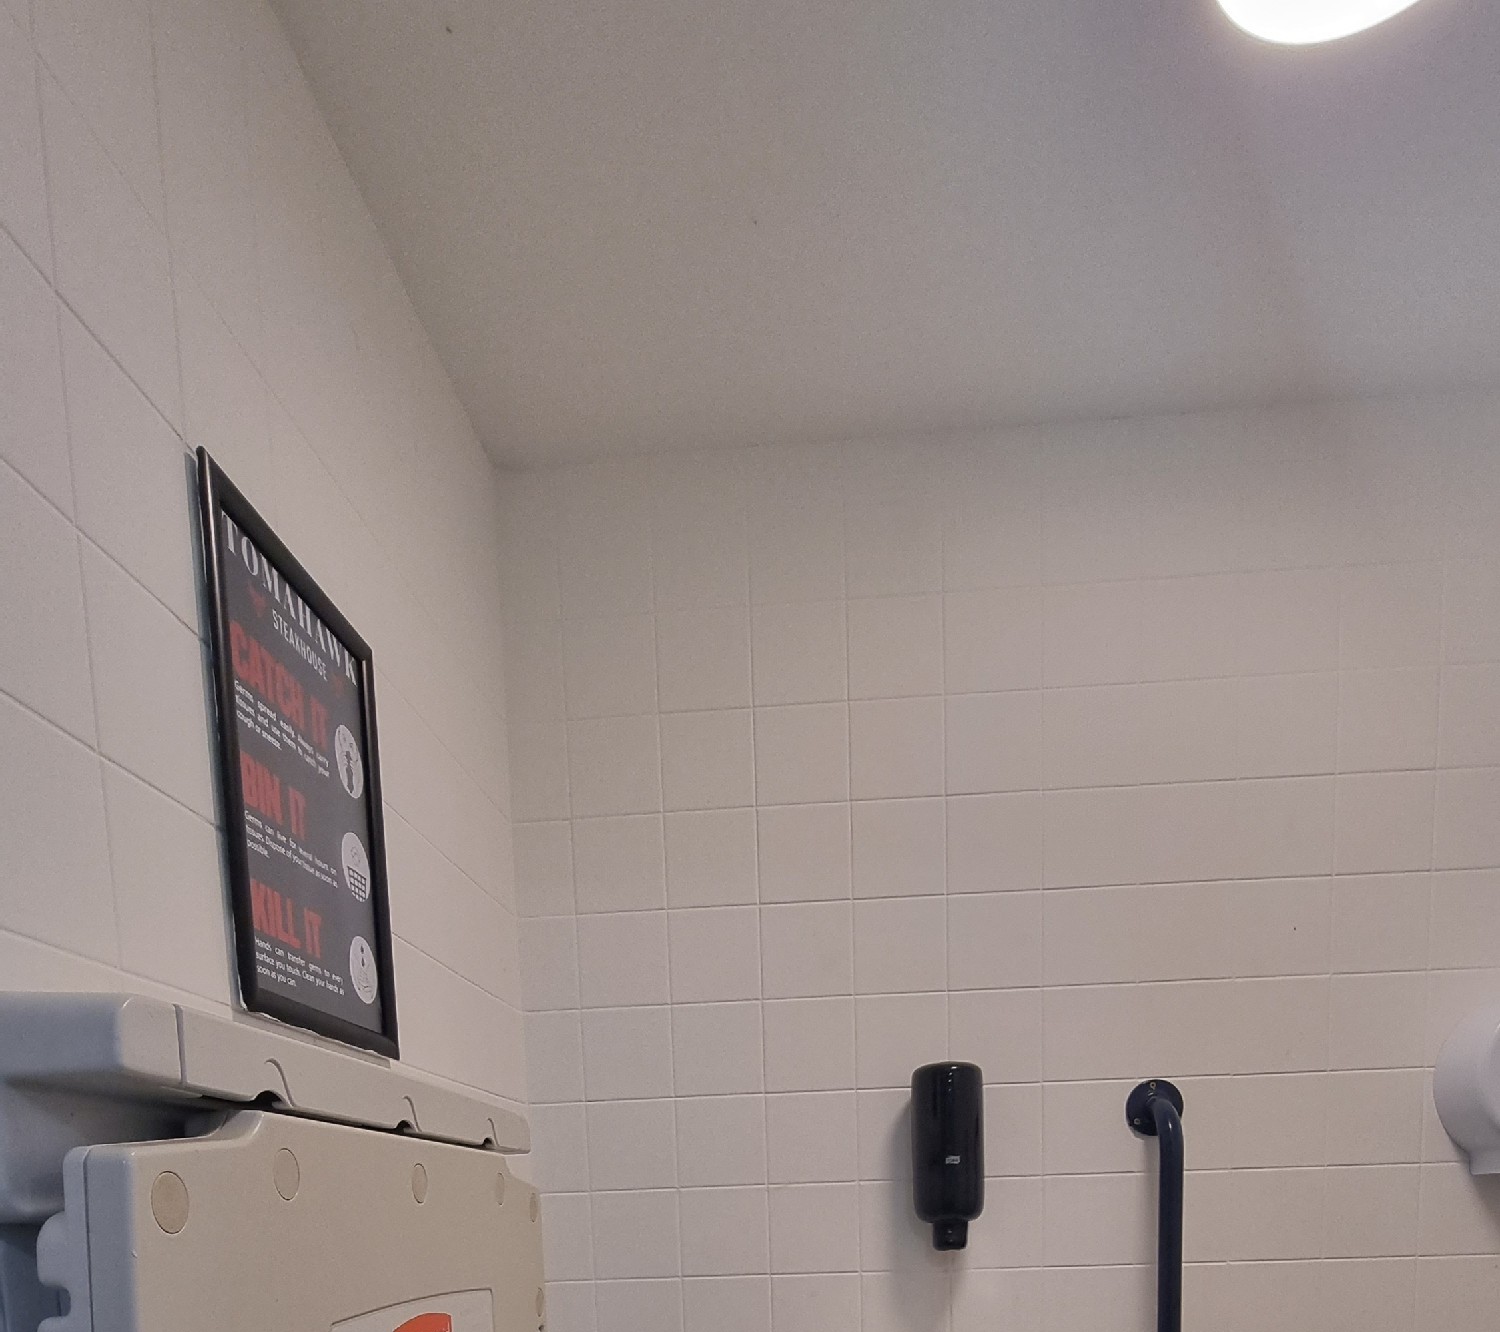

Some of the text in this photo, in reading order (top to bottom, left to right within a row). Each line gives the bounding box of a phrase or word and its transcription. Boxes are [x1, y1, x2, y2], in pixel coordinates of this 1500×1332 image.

[222, 509, 357, 687] TOMAHAWK
[272, 609, 328, 682] STEAKHOUSE
[229, 619, 329, 751] CATCH IT
[234, 680, 254, 703] Germs
[257, 700, 276, 721] spread
[257, 713, 269, 727] and
[240, 750, 306, 840] BIN IT
[244, 810, 263, 828] Germs
[250, 878, 322, 959] KILL IT
[255, 951, 275, 966] surface
